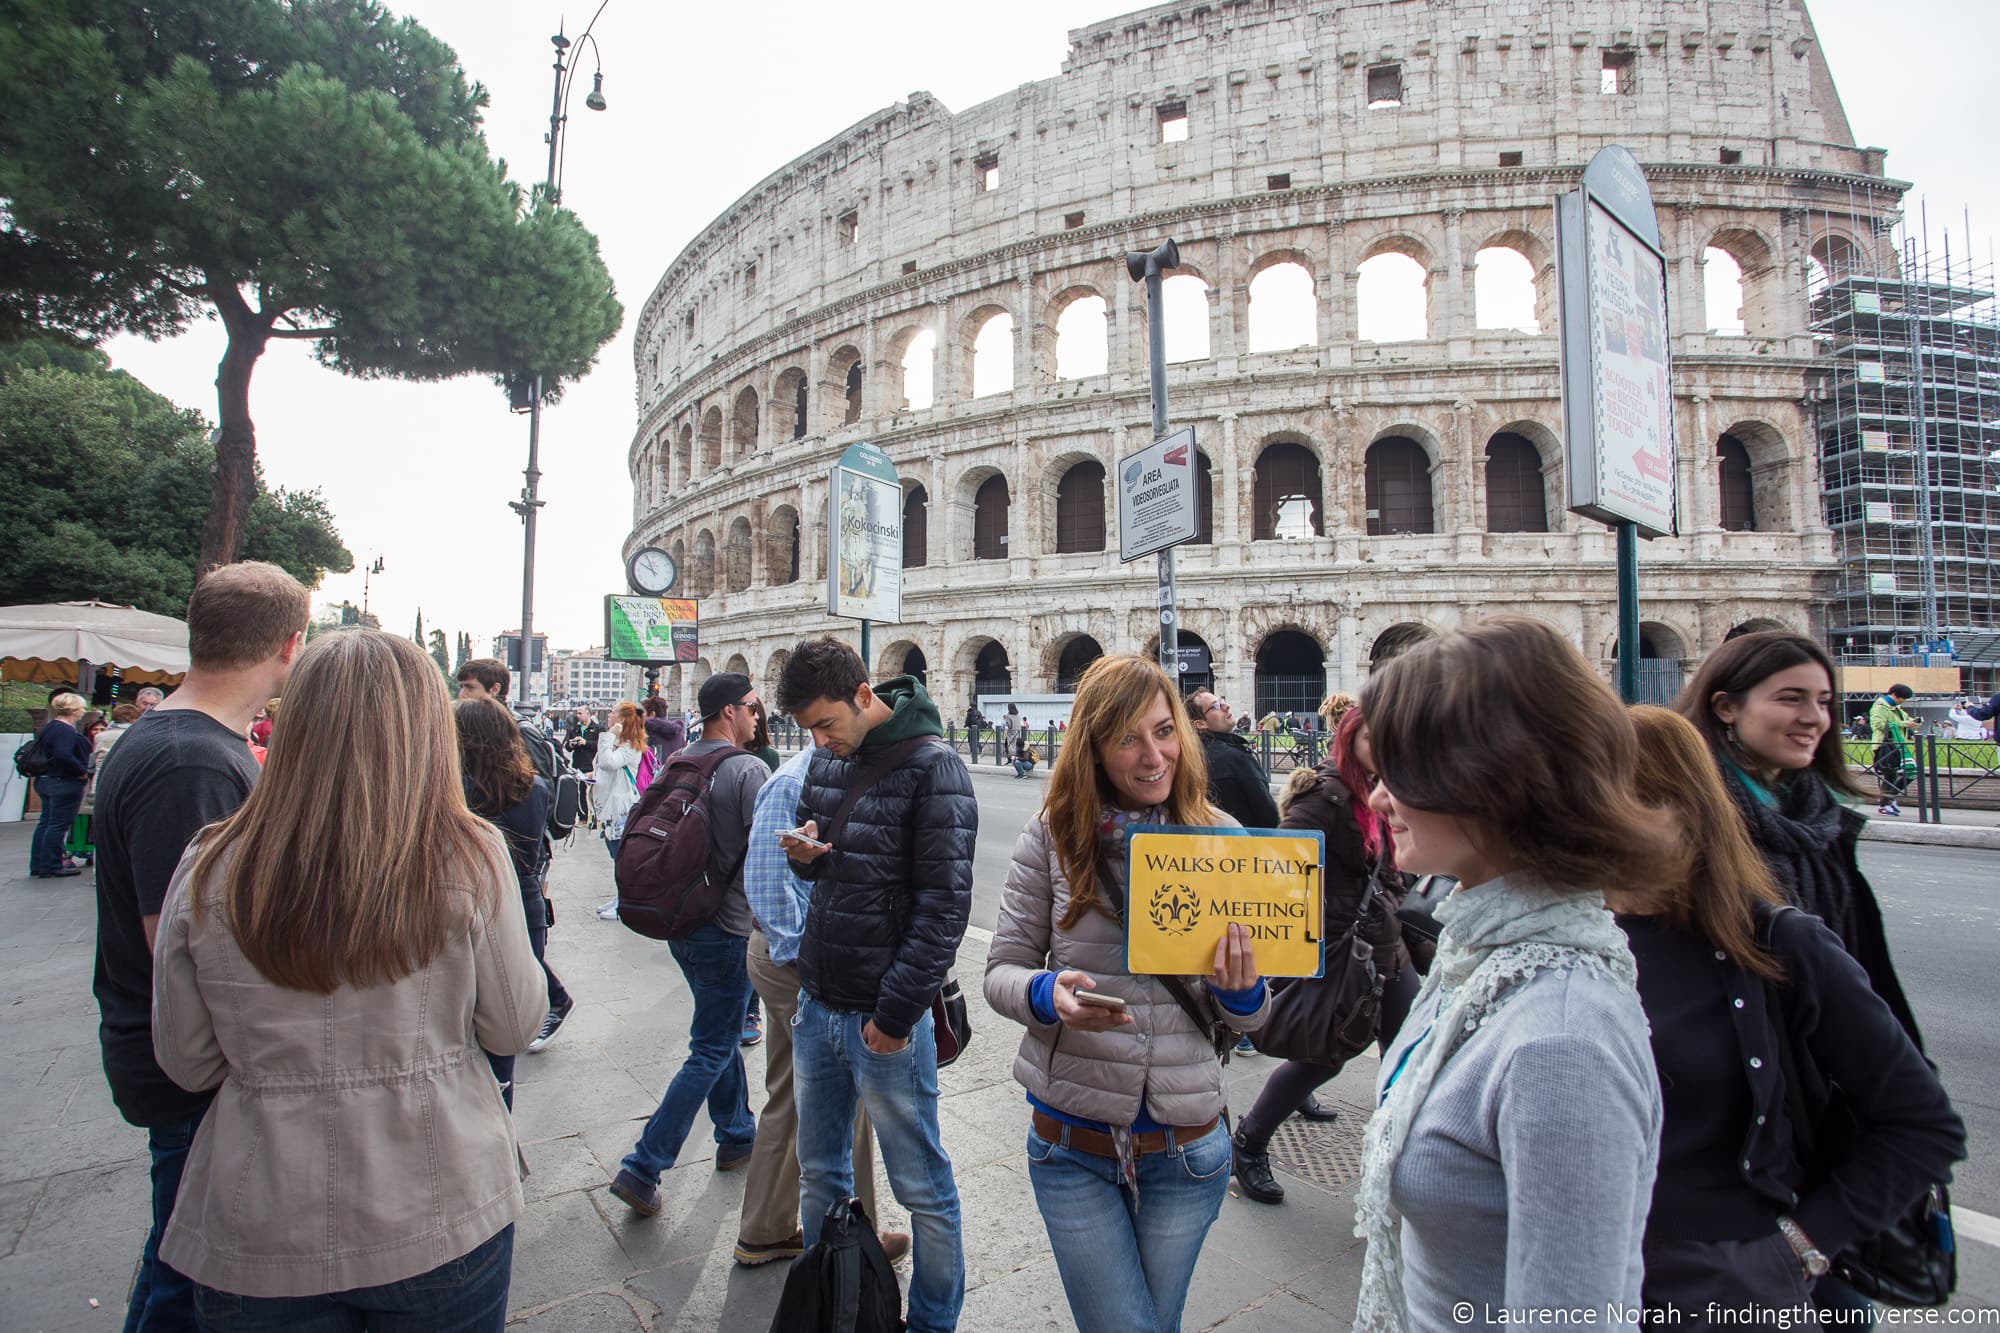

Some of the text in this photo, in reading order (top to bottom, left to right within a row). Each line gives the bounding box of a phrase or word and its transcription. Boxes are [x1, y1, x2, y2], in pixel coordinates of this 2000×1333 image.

[1600, 284, 1635, 320] MUSEUM
[1605, 367, 1642, 400] SCOOTER
[1606, 413, 1634, 440] TOURS
[1142, 467, 1162, 487] AREA
[1132, 478, 1180, 507] VIDEOSORVEGLIATA
[848, 514, 899, 540] Kokocinski
[1145, 854, 1307, 875] WALKS OF ITALY
[1208, 898, 1305, 918] MEETING
